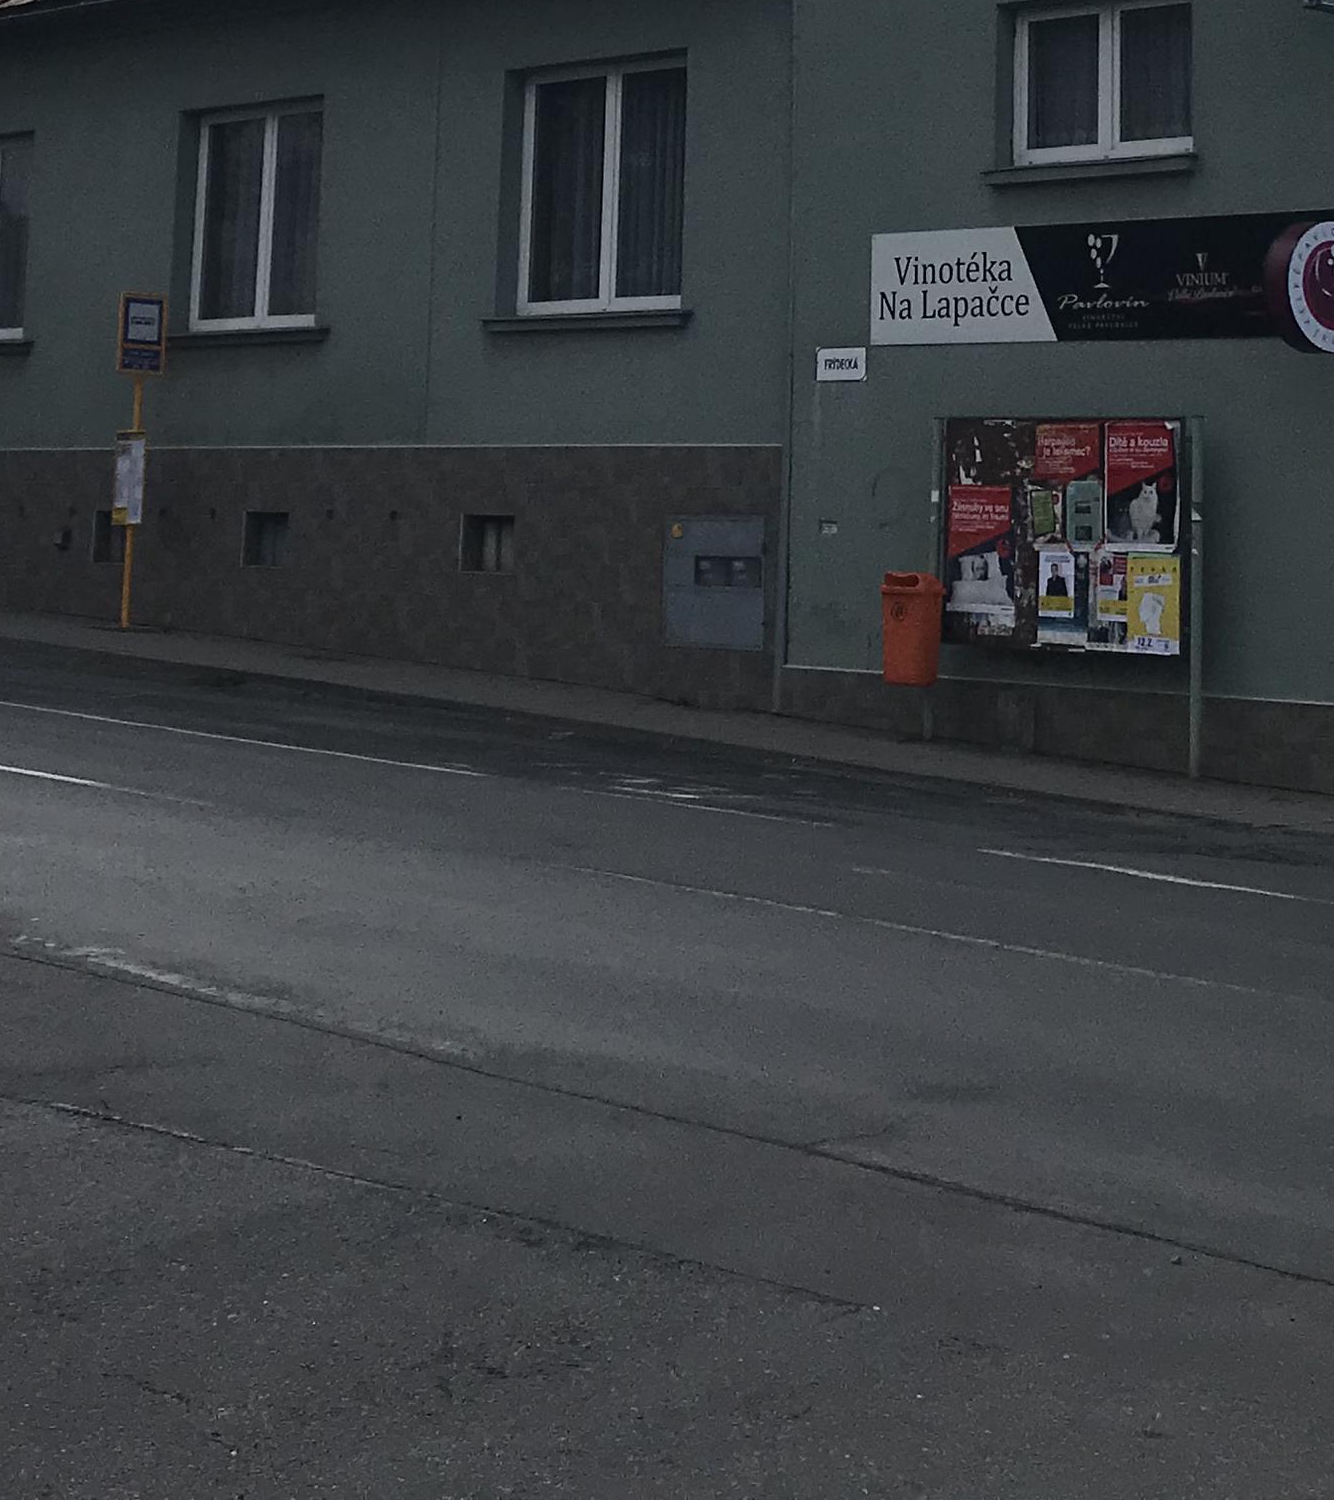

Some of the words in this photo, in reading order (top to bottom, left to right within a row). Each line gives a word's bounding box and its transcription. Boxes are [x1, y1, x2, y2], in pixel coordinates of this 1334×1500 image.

[894, 252, 1013, 286] Vinotéka
[879, 290, 912, 320] Na
[921, 286, 1030, 327] Lapačce
